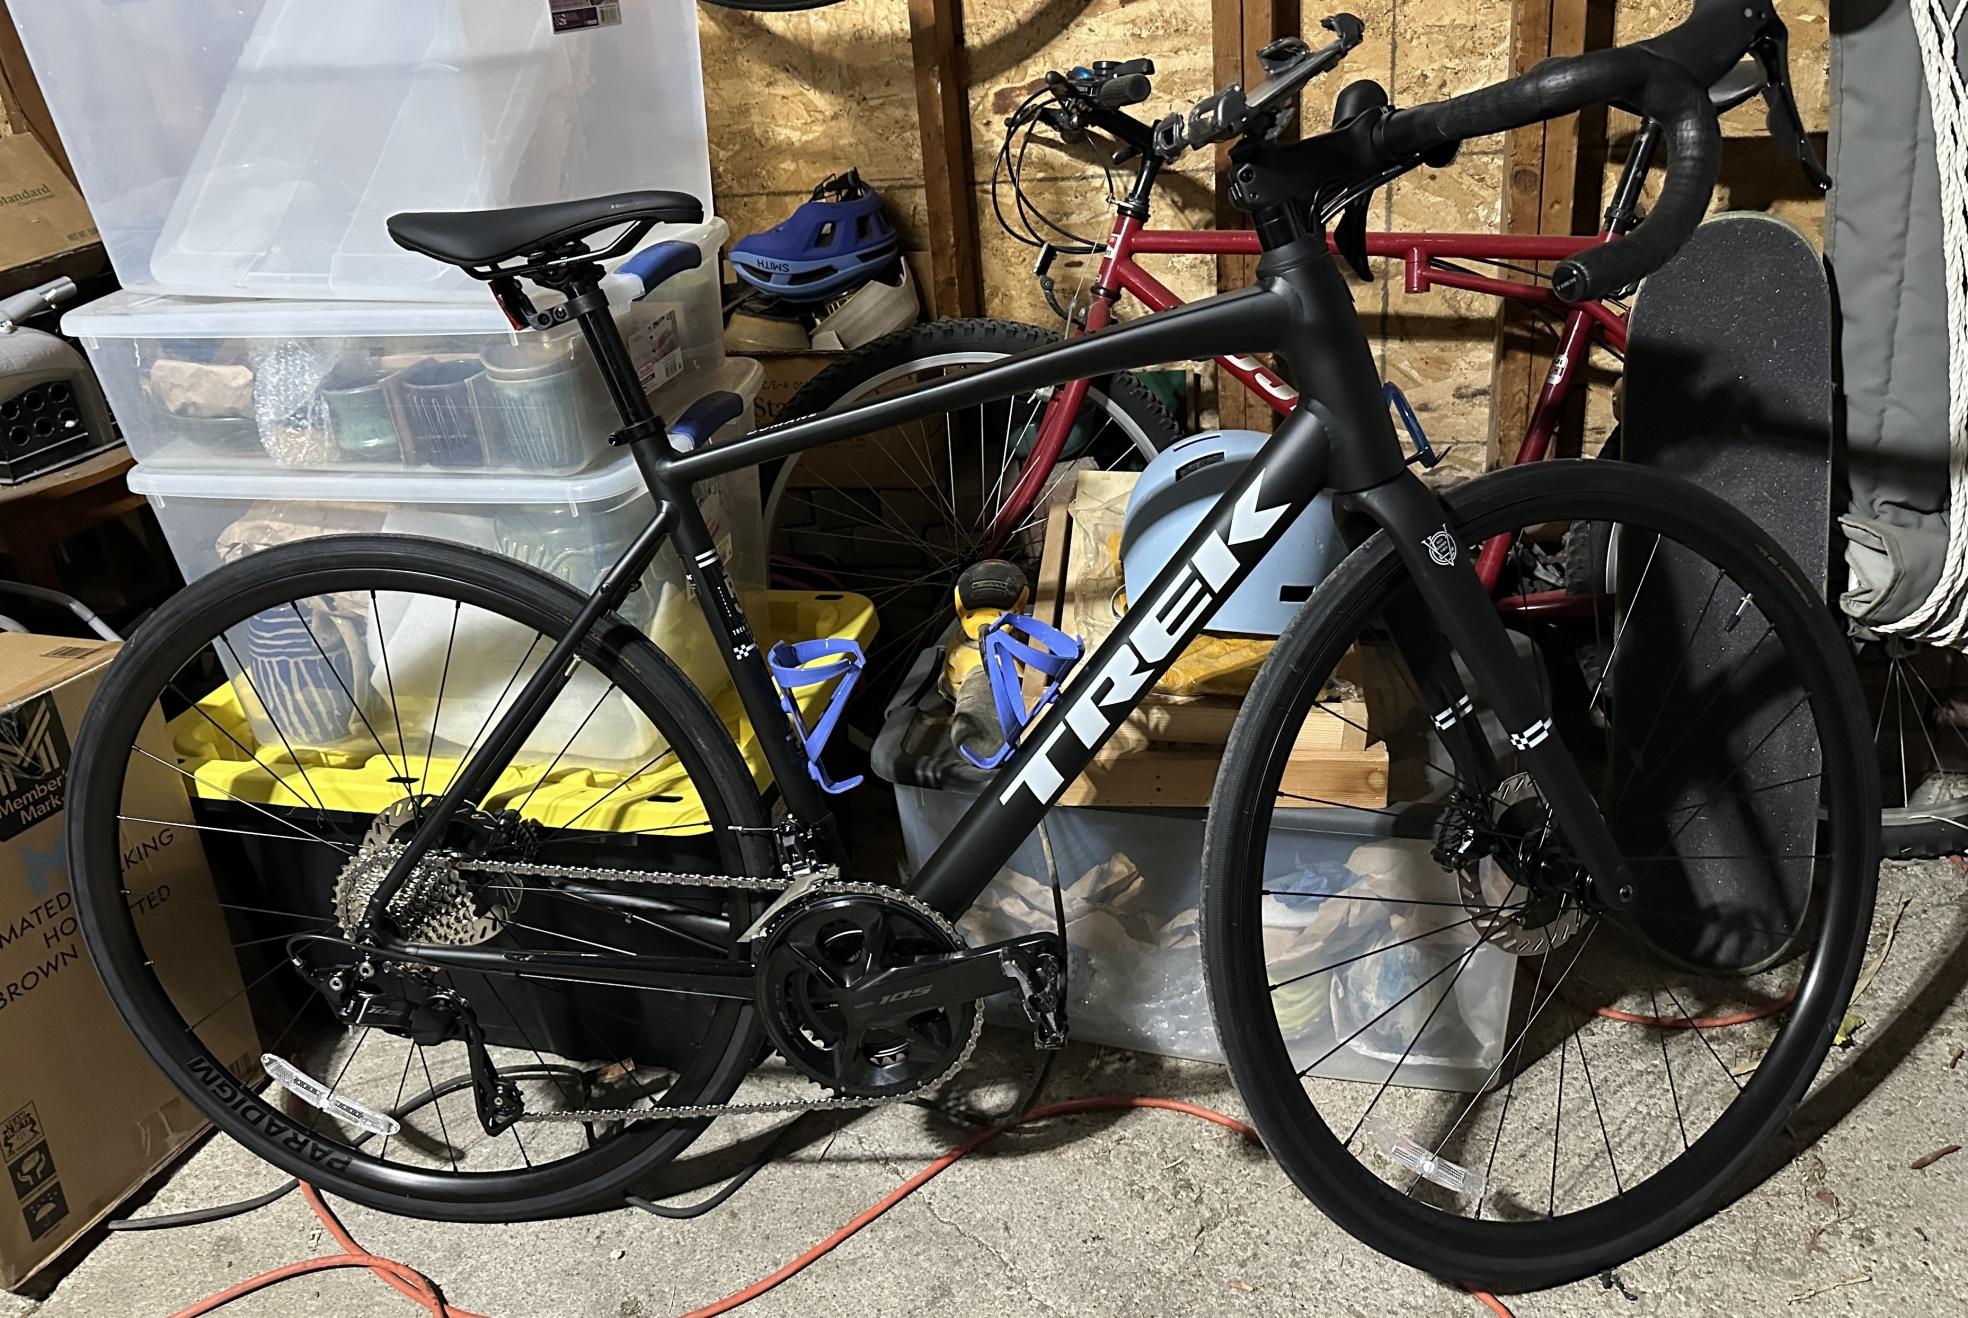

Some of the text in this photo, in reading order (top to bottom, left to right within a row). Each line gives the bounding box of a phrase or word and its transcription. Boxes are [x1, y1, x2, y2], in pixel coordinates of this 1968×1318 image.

[757, 259, 790, 273] SMITH
[1000, 468, 1291, 804] TREK
[0, 767, 69, 818] Member'
[20, 793, 64, 824] Mark
[121, 828, 174, 873] KING
[0, 885, 171, 1010] BROWN TED
[880, 984, 934, 1005] 105
[186, 1055, 353, 1174] PARADIGM
